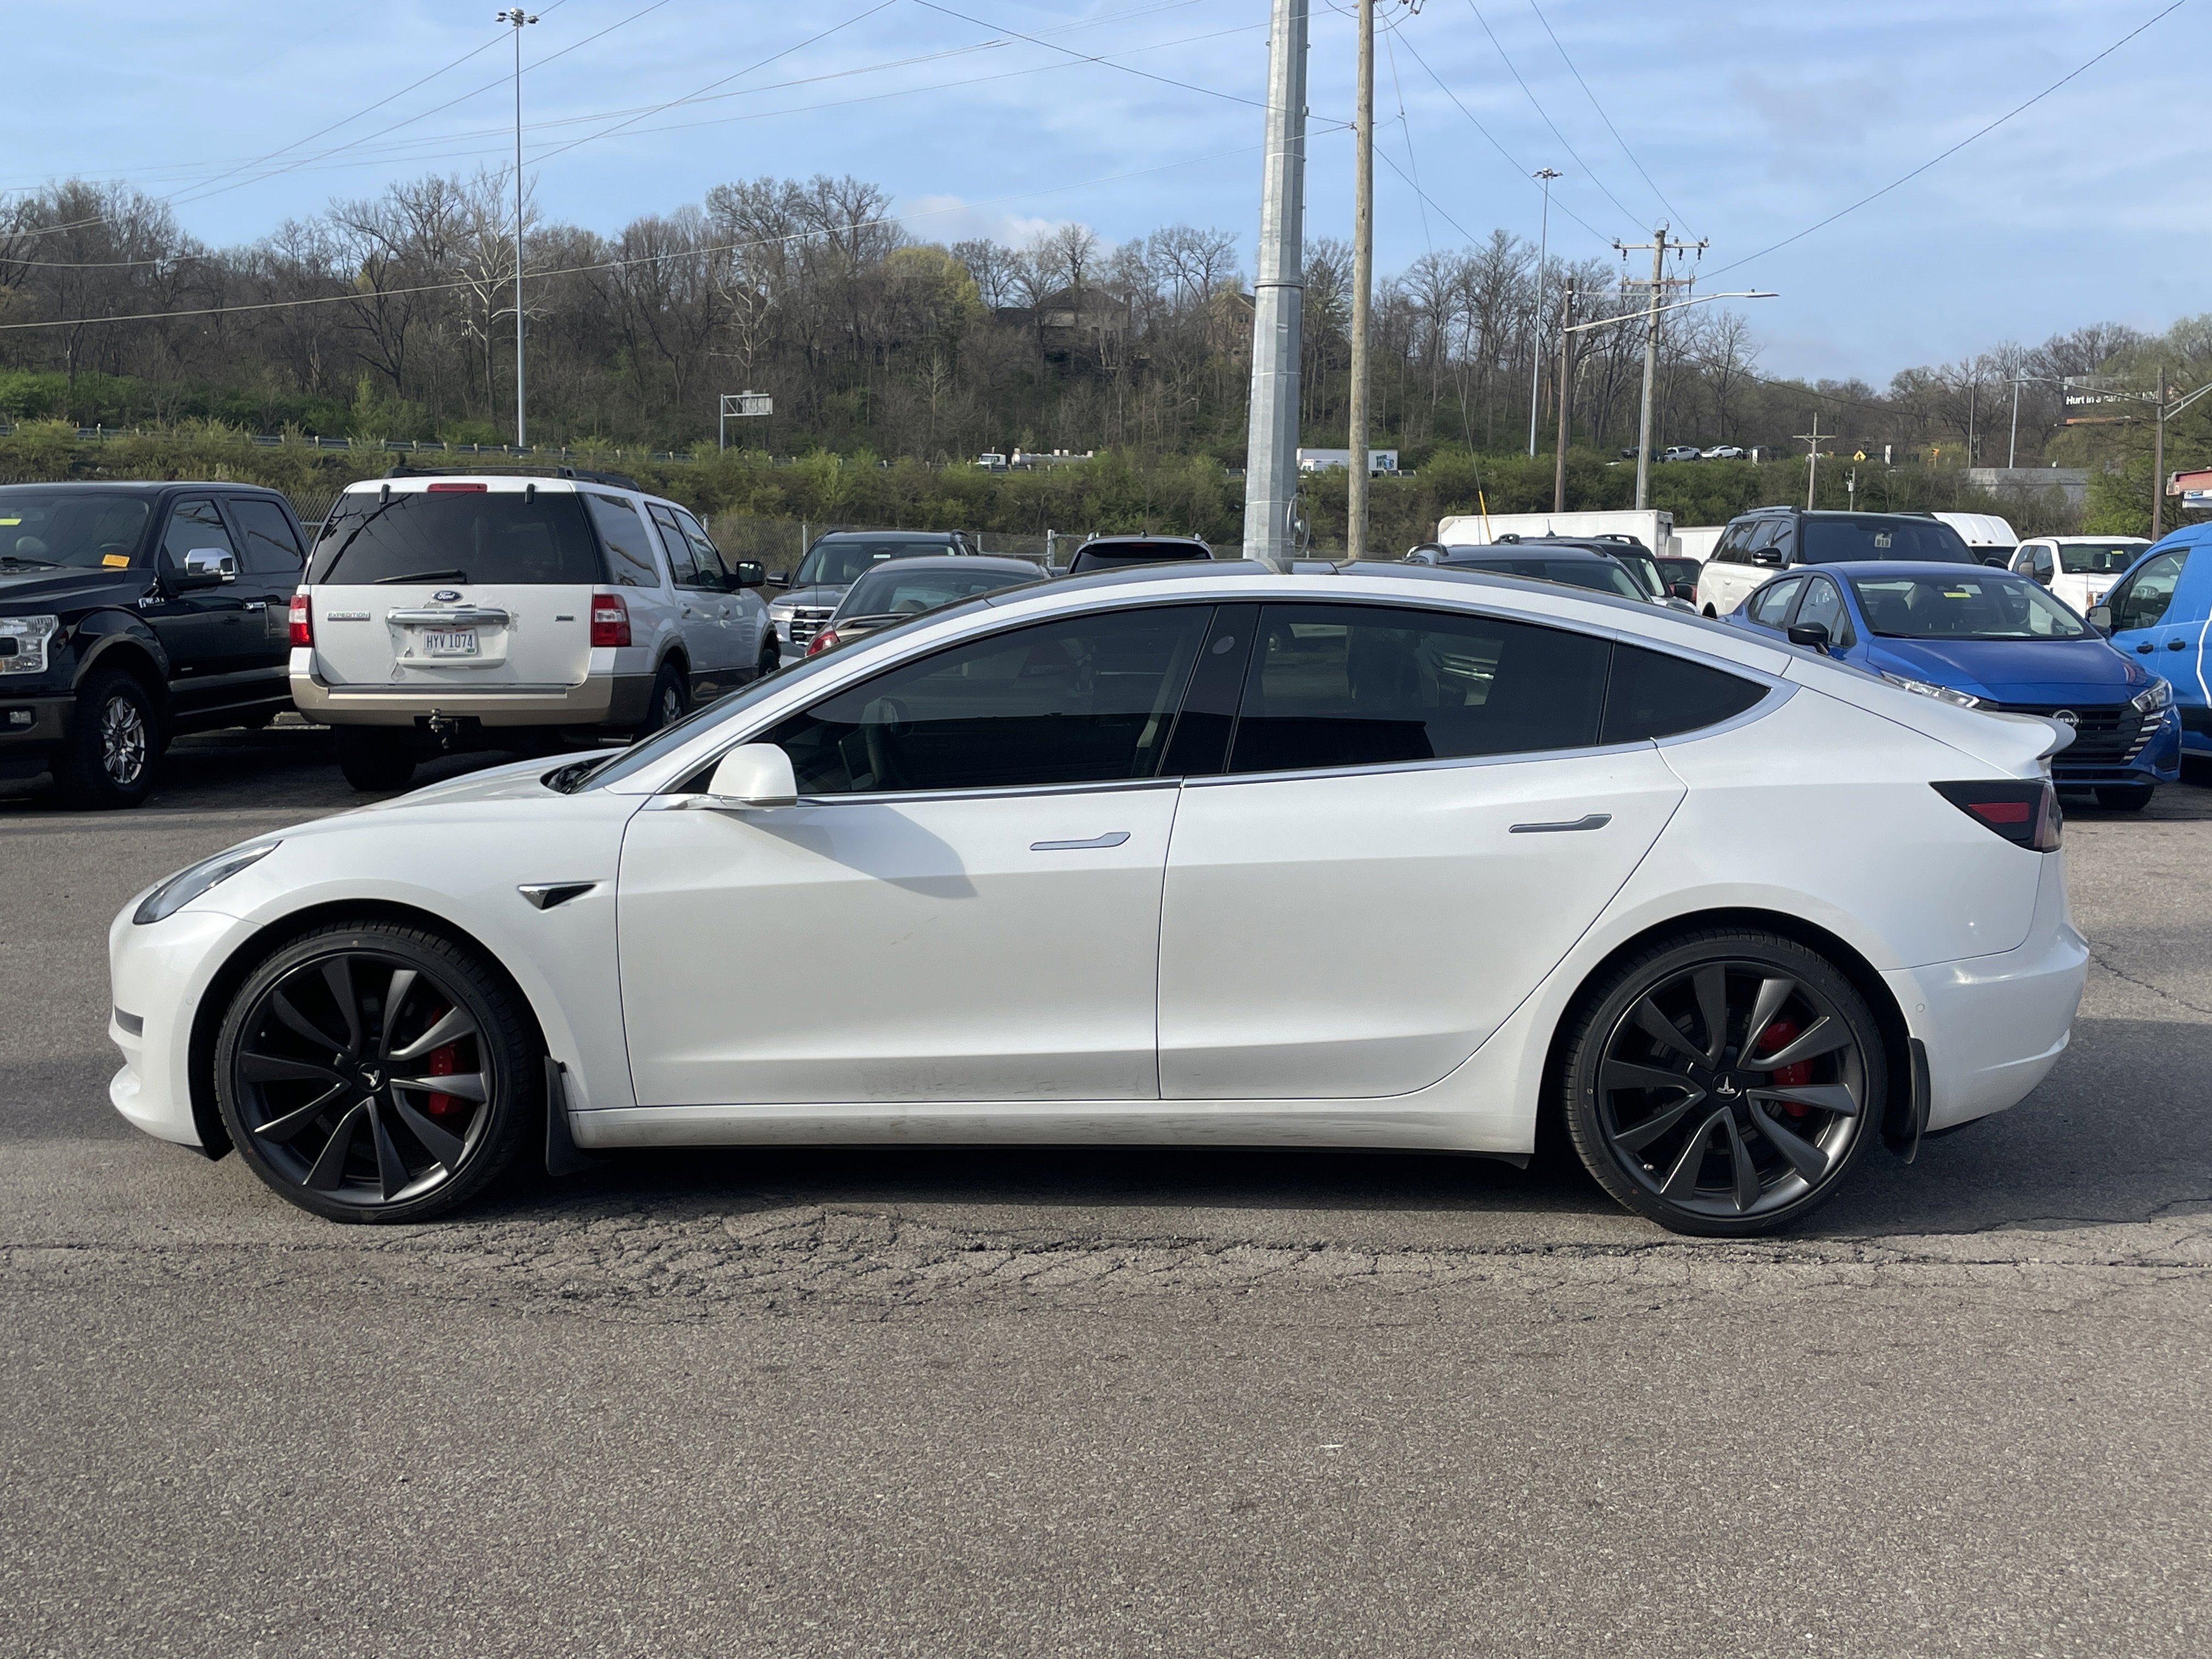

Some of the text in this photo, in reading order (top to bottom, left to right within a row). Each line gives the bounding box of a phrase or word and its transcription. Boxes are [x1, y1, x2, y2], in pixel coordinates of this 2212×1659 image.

[2066, 396, 2084, 405] Hurt
[2086, 396, 2094, 404] in
[427, 634, 472, 648] HYV 1074
